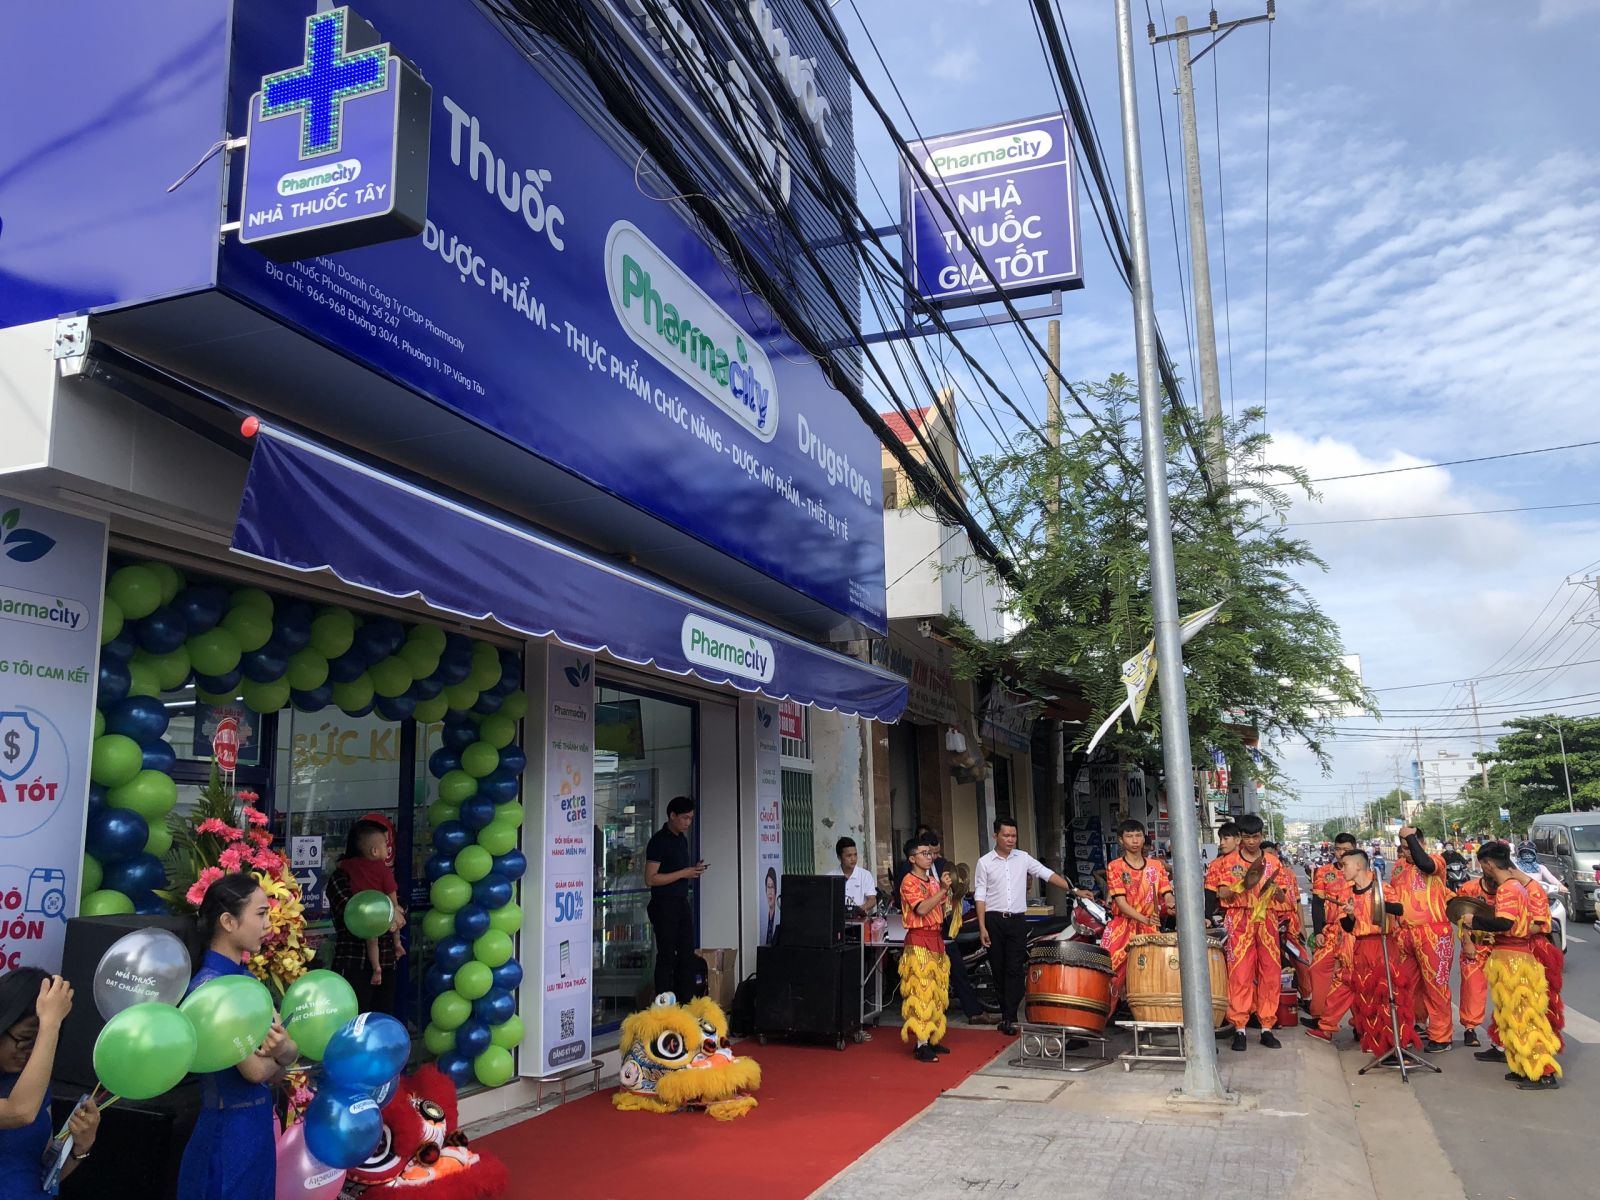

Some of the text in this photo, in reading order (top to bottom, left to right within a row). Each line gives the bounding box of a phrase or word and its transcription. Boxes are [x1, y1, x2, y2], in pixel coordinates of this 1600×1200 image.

[442, 95, 566, 252] Thuốc
[934, 137, 1042, 173] Pharmacity
[281, 164, 357, 193] Pharmacity
[957, 179, 1022, 216] NHÀ
[248, 184, 387, 228] NHÀ THUỐC TÂY
[940, 209, 1043, 254] THUỐC
[994, 243, 1049, 280] TỐT
[266, 260, 283, 282] Địa
[307, 285, 346, 316] 966-968
[322, 274, 370, 315] Pharmacity
[372, 304, 384, 319] Số
[384, 312, 400, 328] 247
[338, 265, 367, 292] Doanh
[369, 284, 391, 309] Công
[393, 297, 402, 315] Ty
[403, 305, 424, 325] CPDP
[425, 318, 465, 353] Pharmacity
[622, 254, 770, 429] Pharmacity
[422, 219, 486, 287] DƯỢC
[491, 267, 547, 331] PHẨM
[564, 320, 608, 372] THỰC
[610, 354, 652, 404] PHẨM
[654, 388, 689, 430] CHỨC
[690, 414, 723, 454] NĂNG
[732, 443, 760, 480] DƯỢC
[776, 475, 800, 508] PHẨM
[836, 518, 841, 535] Y
[798, 413, 872, 506] Drugstore
[0, 599, 81, 629] armacity
[12, 659, 34, 677] TÔI
[36, 665, 64, 681] CAM
[67, 665, 91, 684] KẾT
[690, 627, 768, 677] Pharmacity
[15, 775, 58, 803] TỐT
[561, 795, 586, 811] extra
[566, 808, 587, 823] care
